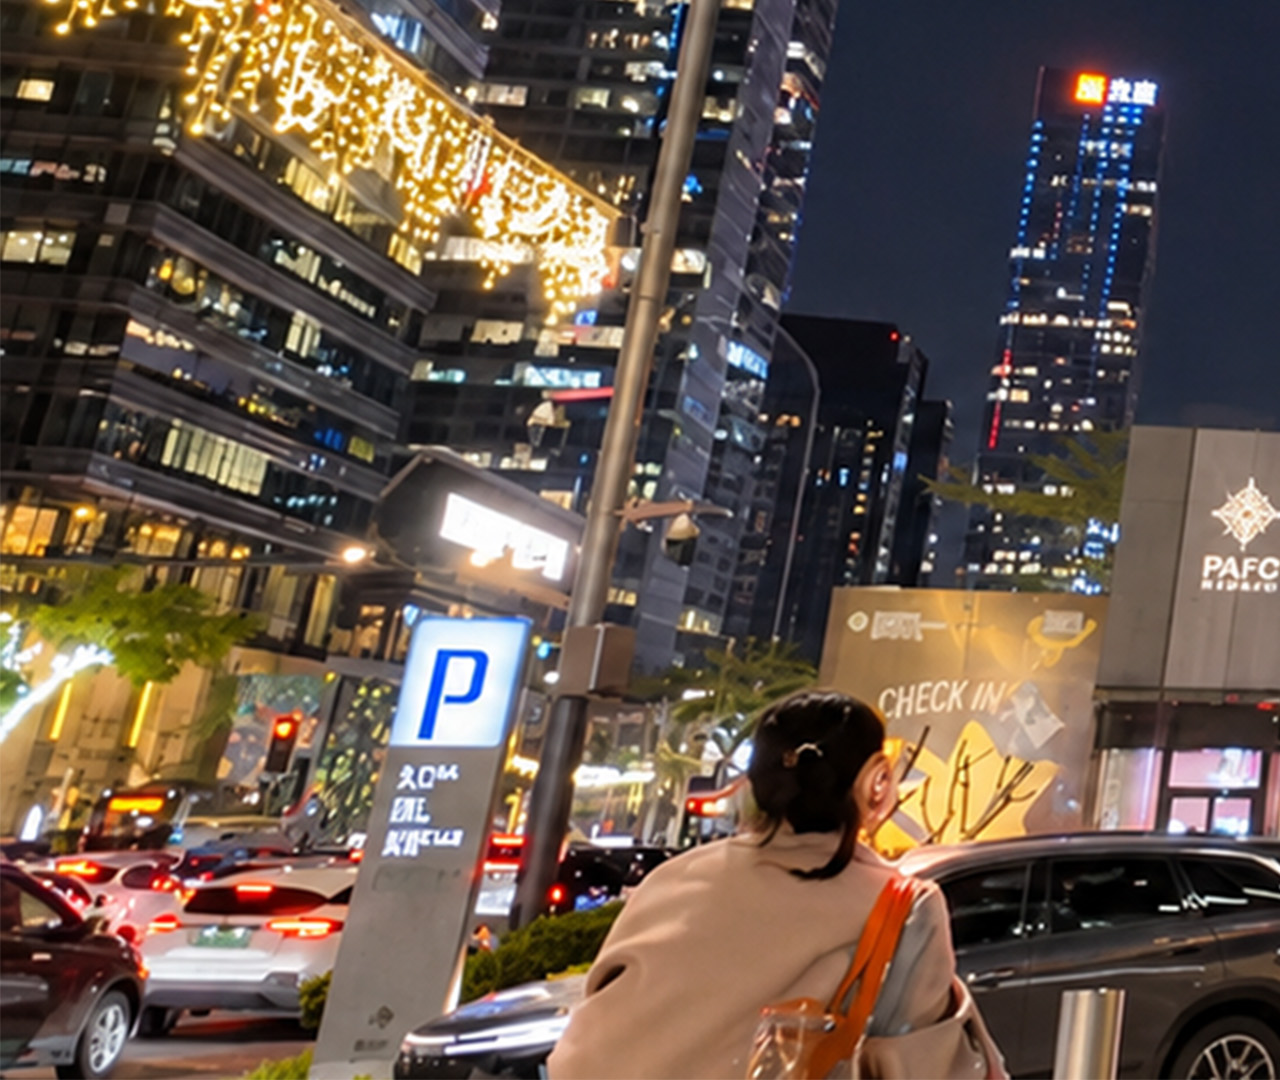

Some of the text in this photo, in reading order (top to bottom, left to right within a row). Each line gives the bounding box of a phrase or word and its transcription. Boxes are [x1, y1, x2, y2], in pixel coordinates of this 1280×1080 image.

[417, 648, 490, 740] P
[878, 678, 1008, 719] CHECK IN
